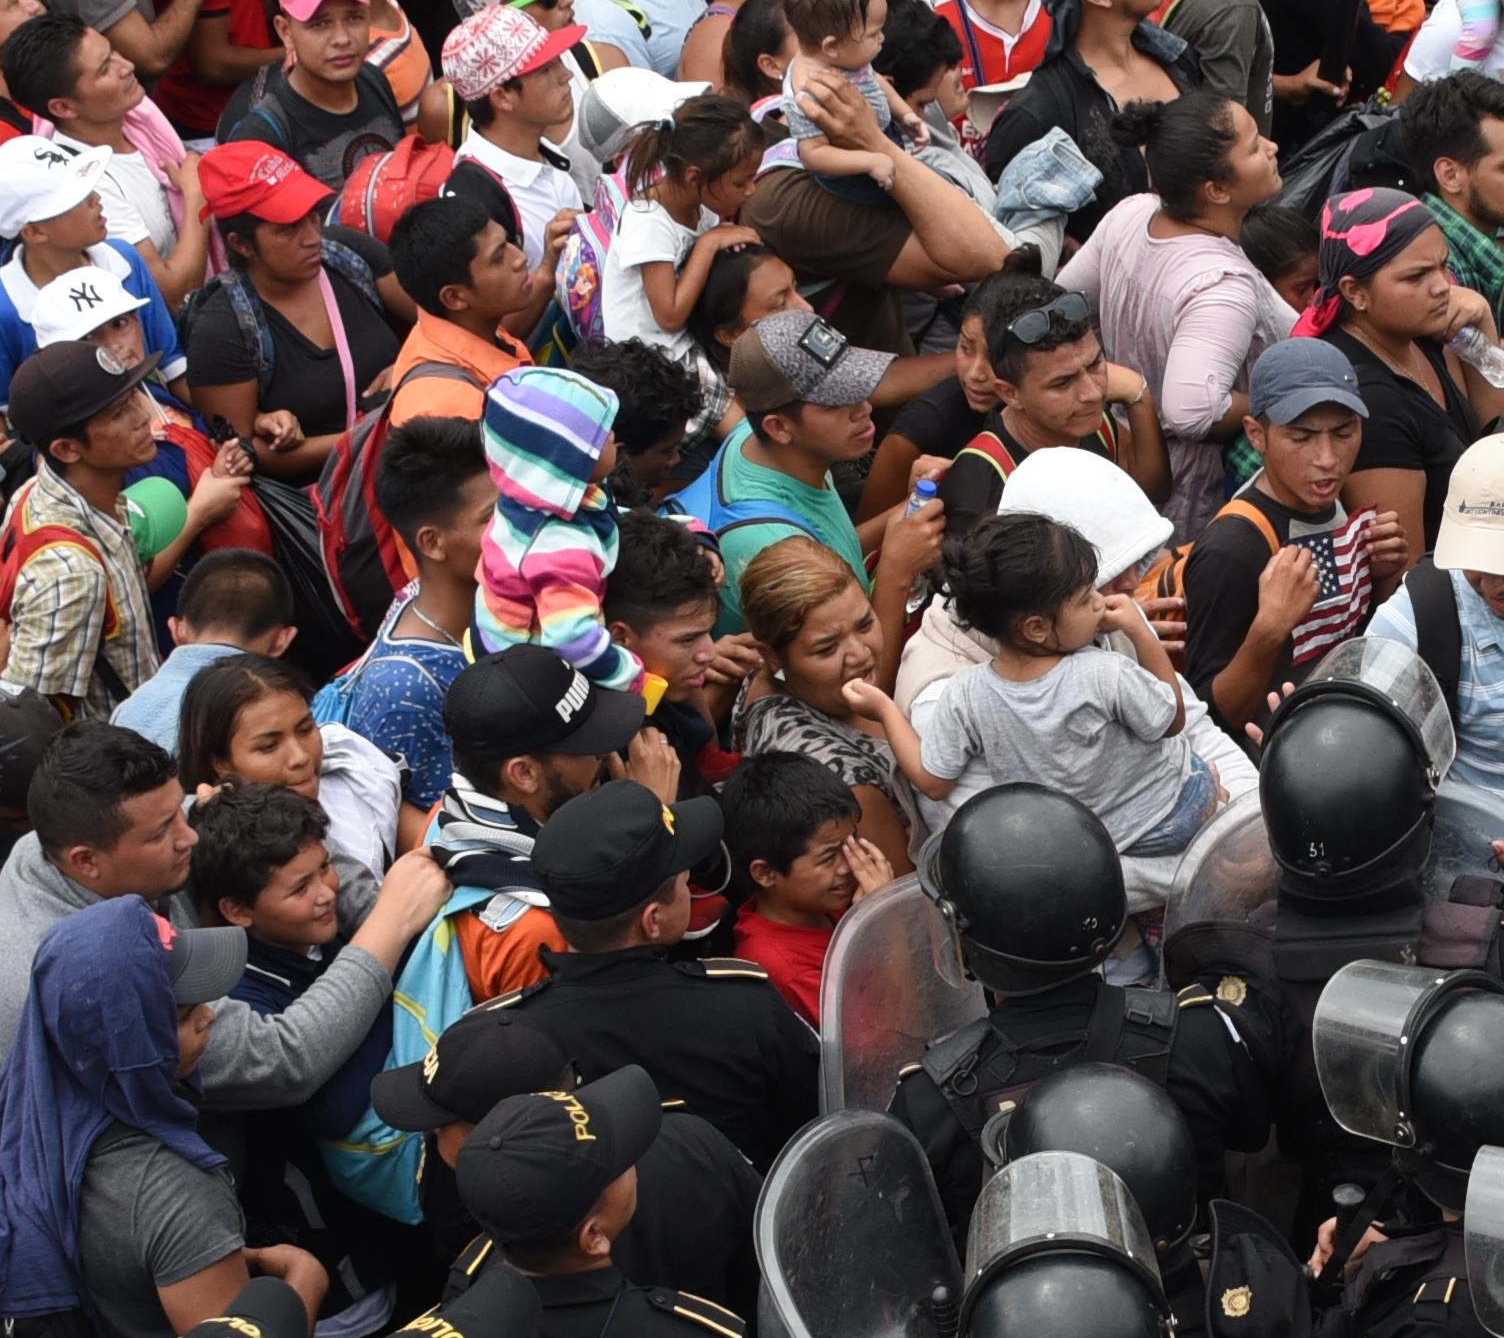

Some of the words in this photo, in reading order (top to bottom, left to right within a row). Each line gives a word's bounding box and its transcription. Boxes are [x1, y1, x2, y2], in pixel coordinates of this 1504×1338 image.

[69, 282, 104, 312] NY
[555, 670, 591, 724] PUM
[536, 1091, 597, 1141] POLIC
